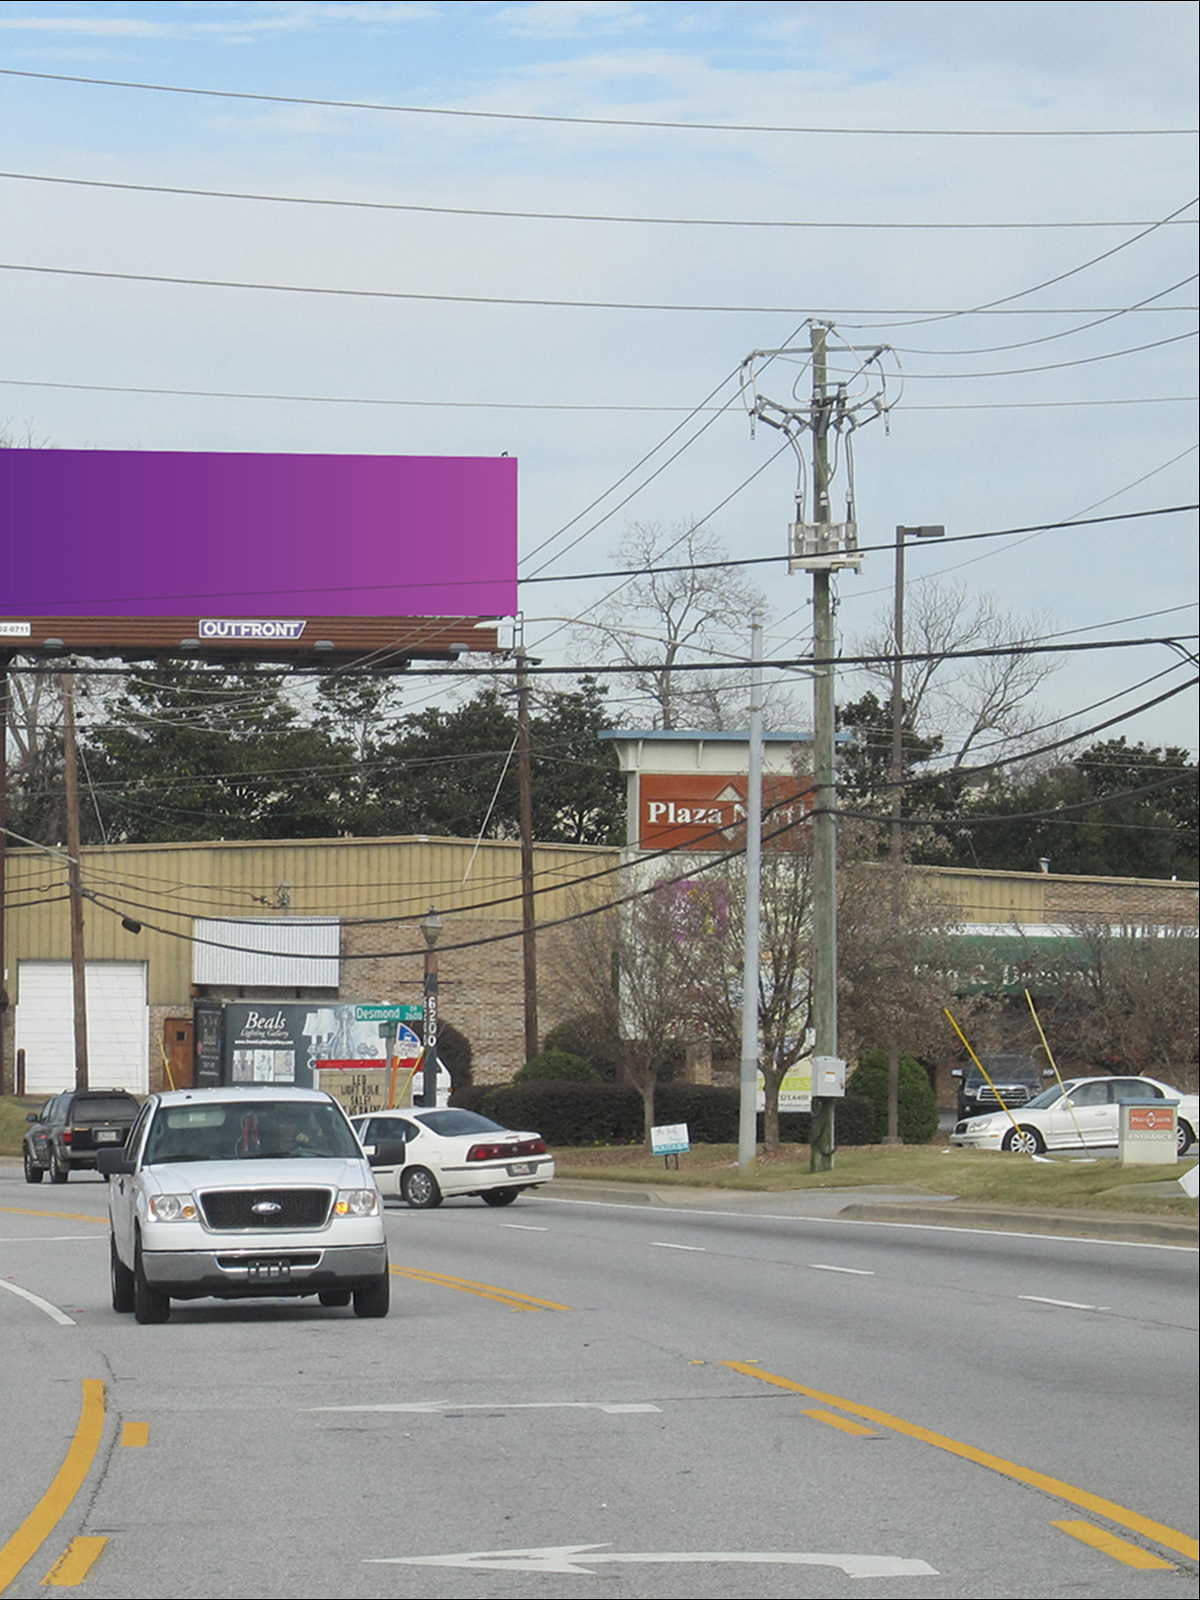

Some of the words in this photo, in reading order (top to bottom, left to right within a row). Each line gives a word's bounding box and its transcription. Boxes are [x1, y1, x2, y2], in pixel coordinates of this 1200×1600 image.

[203, 621, 299, 637] OUTFRONT
[647, 801, 722, 824] Plaza
[245, 1010, 287, 1030] Beals
[356, 1008, 400, 1019] Desmond
[428, 996, 437, 1047] 6200
